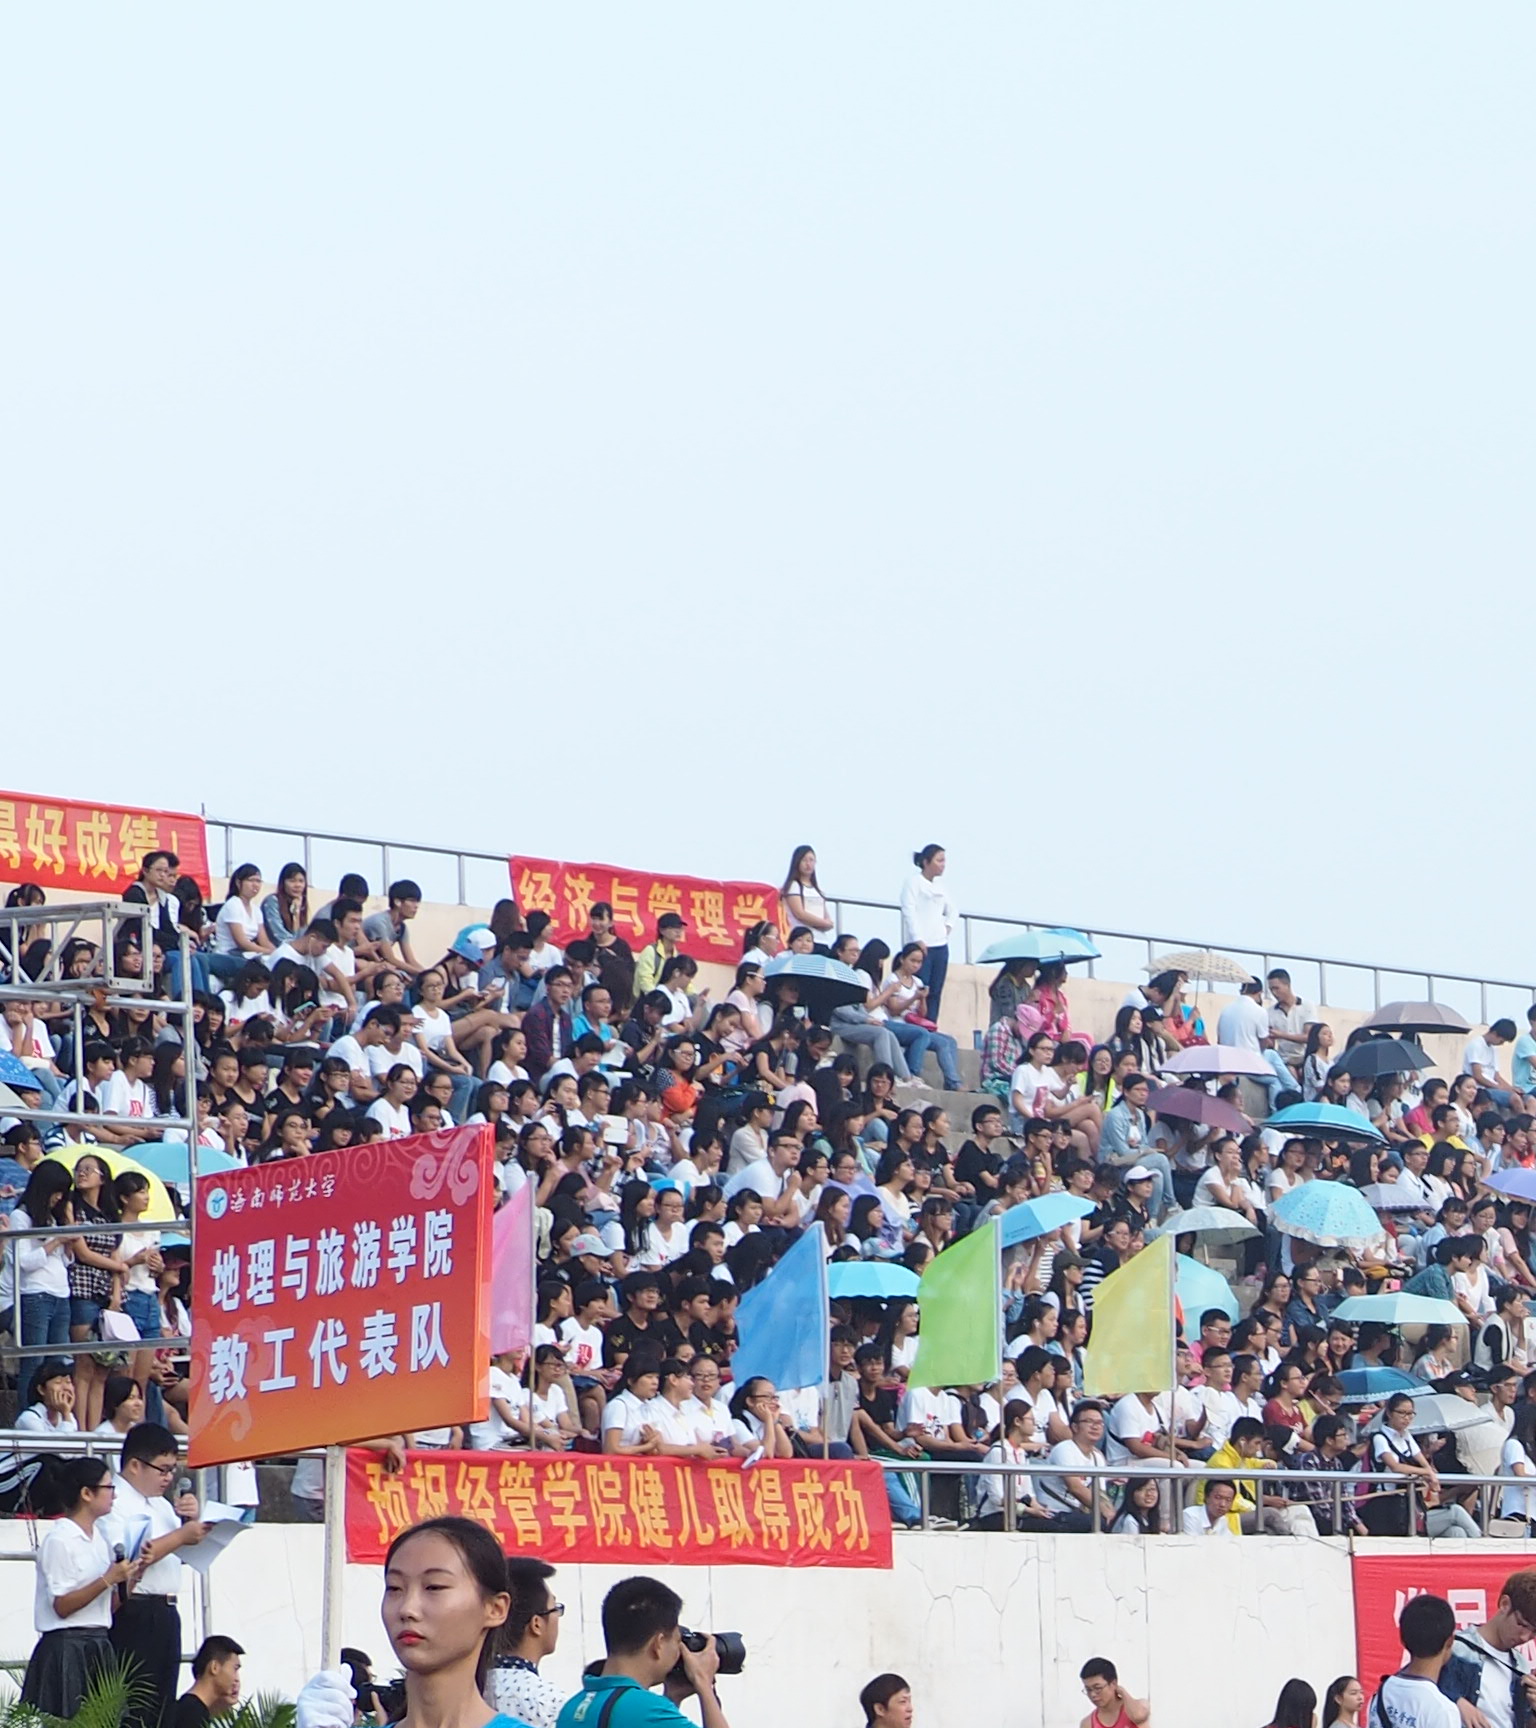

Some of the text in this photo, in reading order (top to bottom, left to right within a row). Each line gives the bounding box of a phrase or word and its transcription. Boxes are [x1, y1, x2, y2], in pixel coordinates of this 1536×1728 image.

[229, 1174, 336, 1213] 海南师范大学
[211, 1208, 453, 1312] 地理与旅游学院
[208, 1301, 450, 1404] 教工代表队
[365, 1460, 870, 1551] 预祝经管学院健儿取得成功
